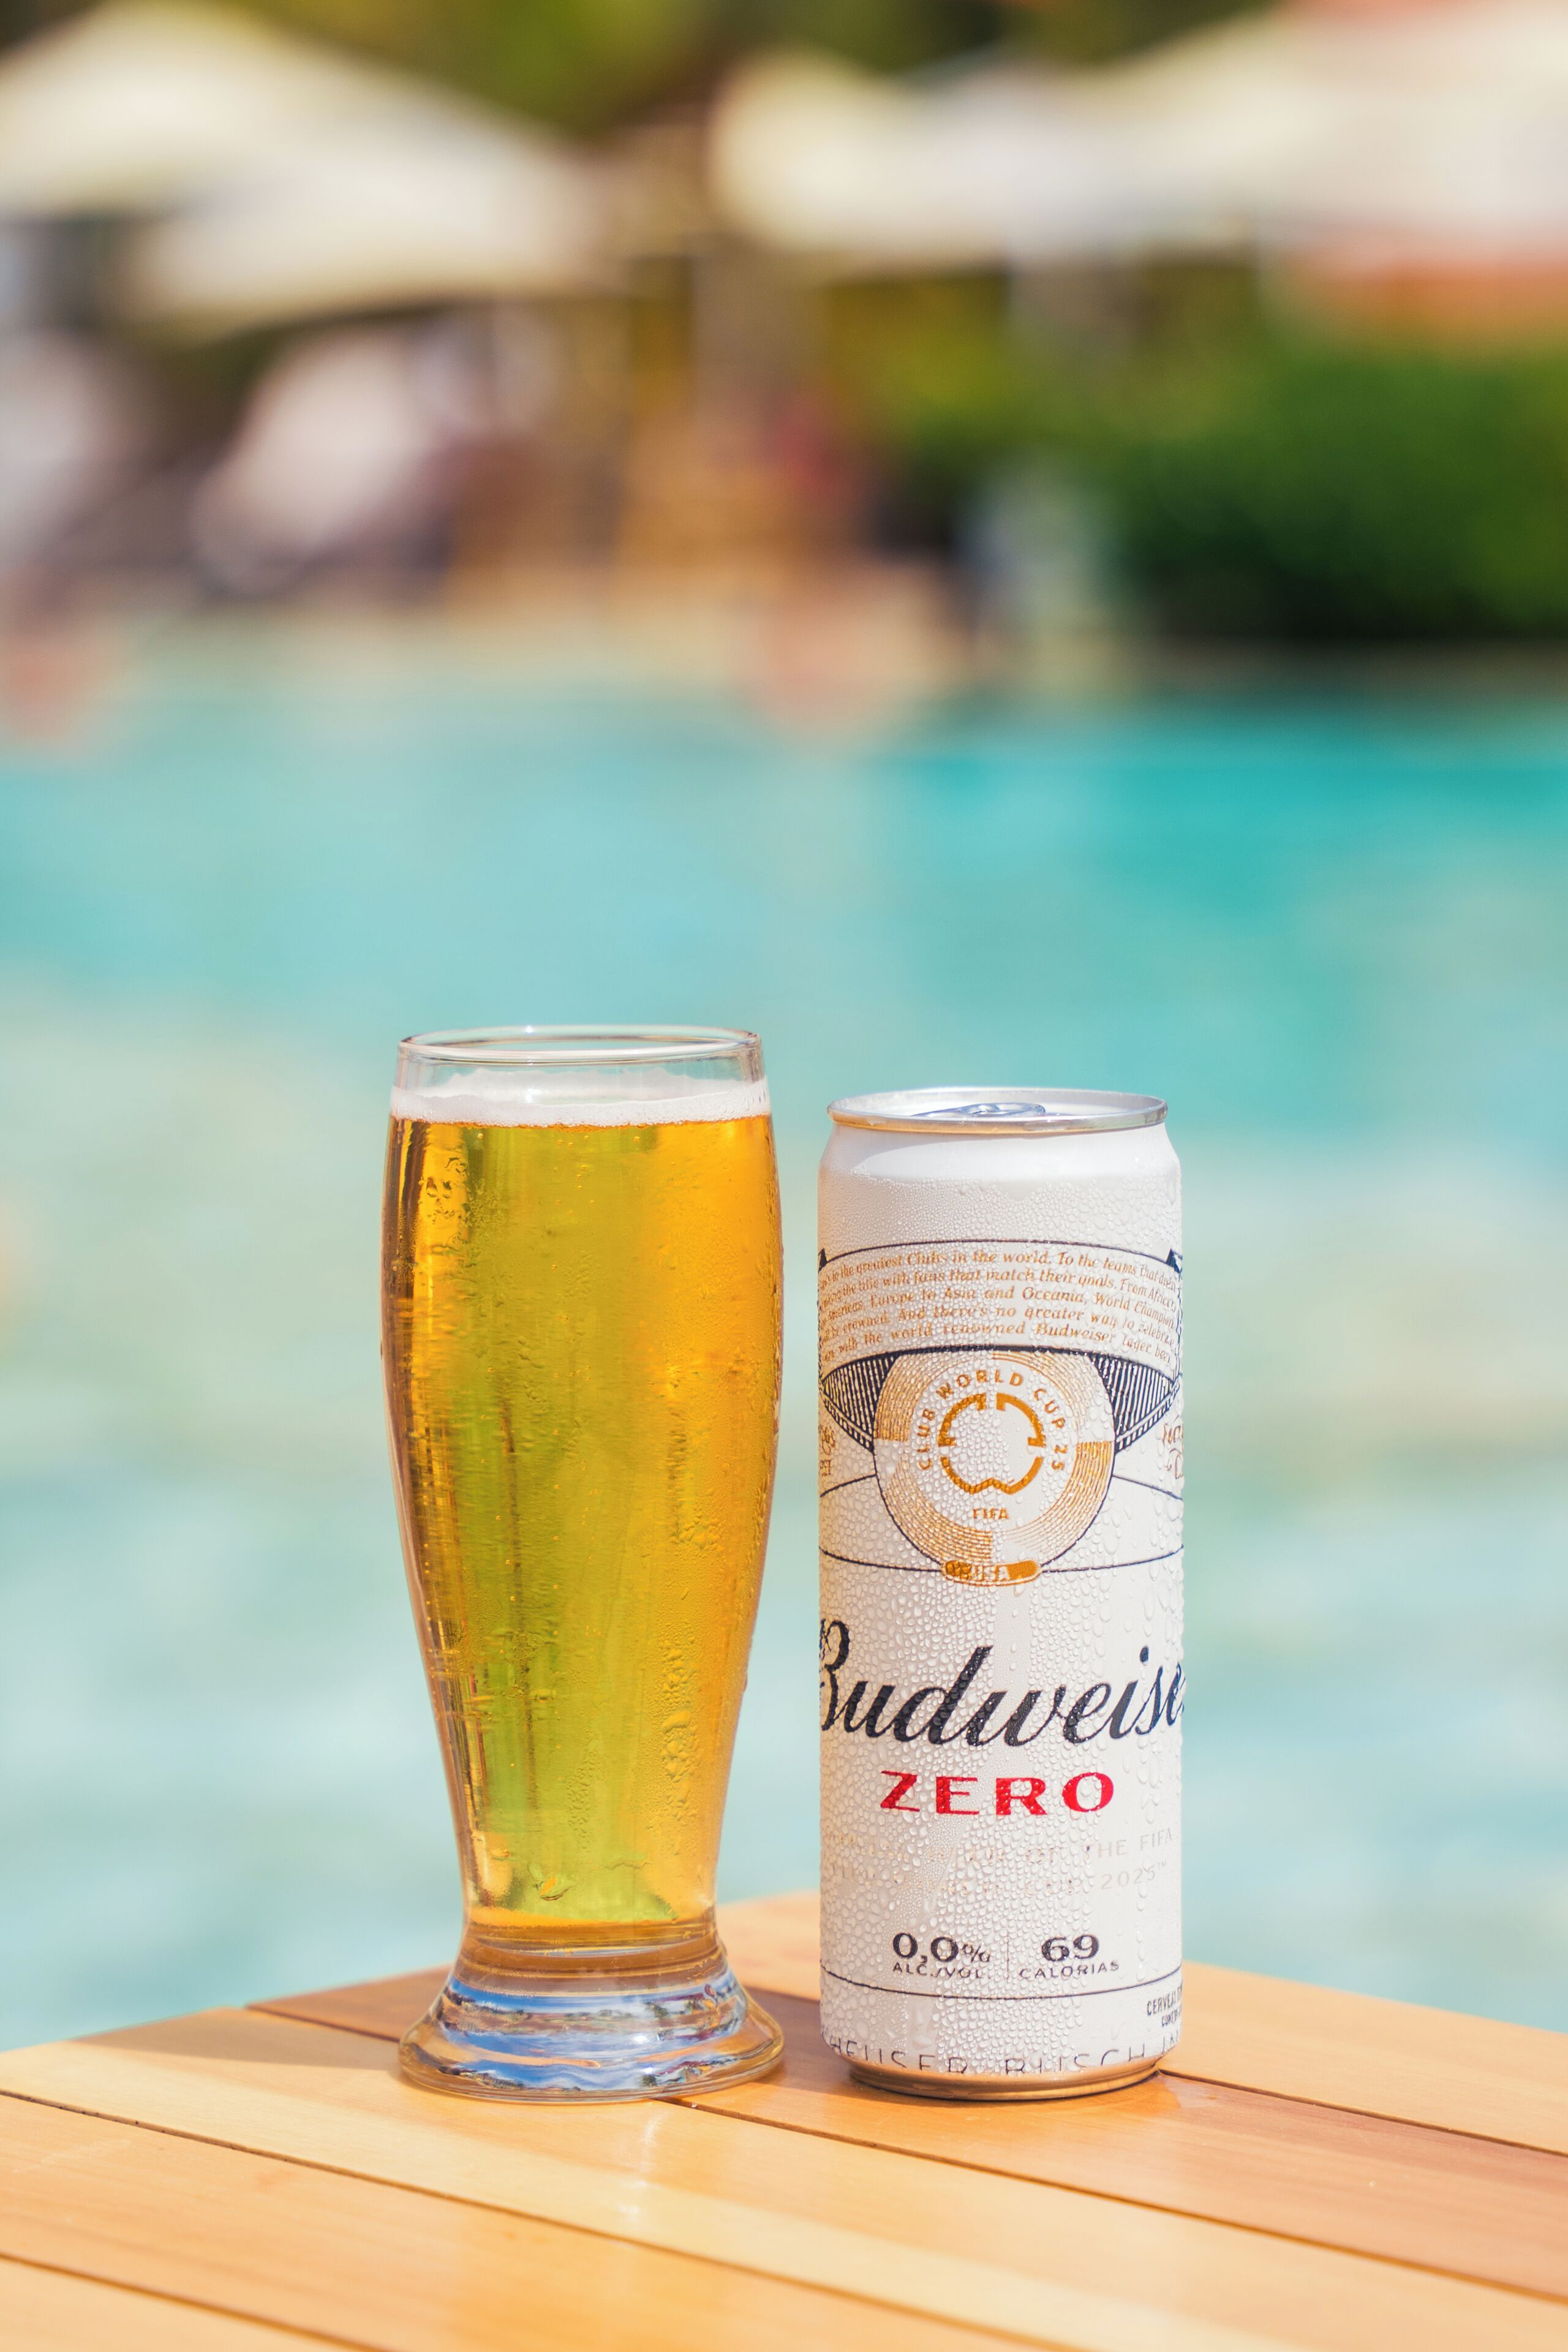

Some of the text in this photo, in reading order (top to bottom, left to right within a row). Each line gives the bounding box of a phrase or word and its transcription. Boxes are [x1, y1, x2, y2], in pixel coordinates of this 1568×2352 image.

[841, 1264, 853, 1278] the
[857, 1254, 902, 1276] greatest
[907, 1250, 948, 1265] Clubs
[952, 1251, 967, 1264] in
[972, 1250, 997, 1263] the
[1003, 1250, 1052, 1264] world.
[1058, 1251, 1074, 1265] To
[1078, 1253, 1098, 1268] the
[1103, 1257, 1136, 1275] teams
[1140, 1264, 1159, 1282] that
[843, 1283, 856, 1297] the
[883, 1270, 910, 1286] with
[912, 1269, 945, 1285] fans
[949, 1268, 981, 1281] that
[986, 1267, 1035, 1282] match
[1039, 1267, 1076, 1284] their
[1078, 1273, 1117, 1290] goals.
[1120, 1278, 1147, 1297] From
[870, 1292, 914, 1308] Europe
[921, 1288, 936, 1300] to
[945, 1287, 976, 1299] Asia
[984, 1285, 1015, 1300] and
[1022, 1286, 1088, 1305] Oceania,
[1094, 1292, 1131, 1311] World
[899, 1305, 925, 1321] And
[995, 1307, 1017, 1317] no
[1024, 1306, 1084, 1321] greater
[1090, 1313, 1118, 1329] way
[1122, 1316, 1135, 1330] to
[864, 1330, 883, 1345] the
[891, 1322, 932, 1340] world
[943, 1321, 1026, 1335] renowned
[1036, 1322, 1117, 1343] Budweiser
[917, 1369, 1068, 1471] CLUB WORLD CUP 25
[973, 1507, 1009, 1520] FIFA
[880, 1770, 1115, 1816] ZERO
[1139, 1828, 1172, 1852] FIFA
[892, 1932, 991, 1964] 0,0%
[1041, 1934, 1100, 1962] 69
[892, 1961, 992, 1980] ALC./VOL.
[1019, 1959, 1120, 1980] CALORIAS
